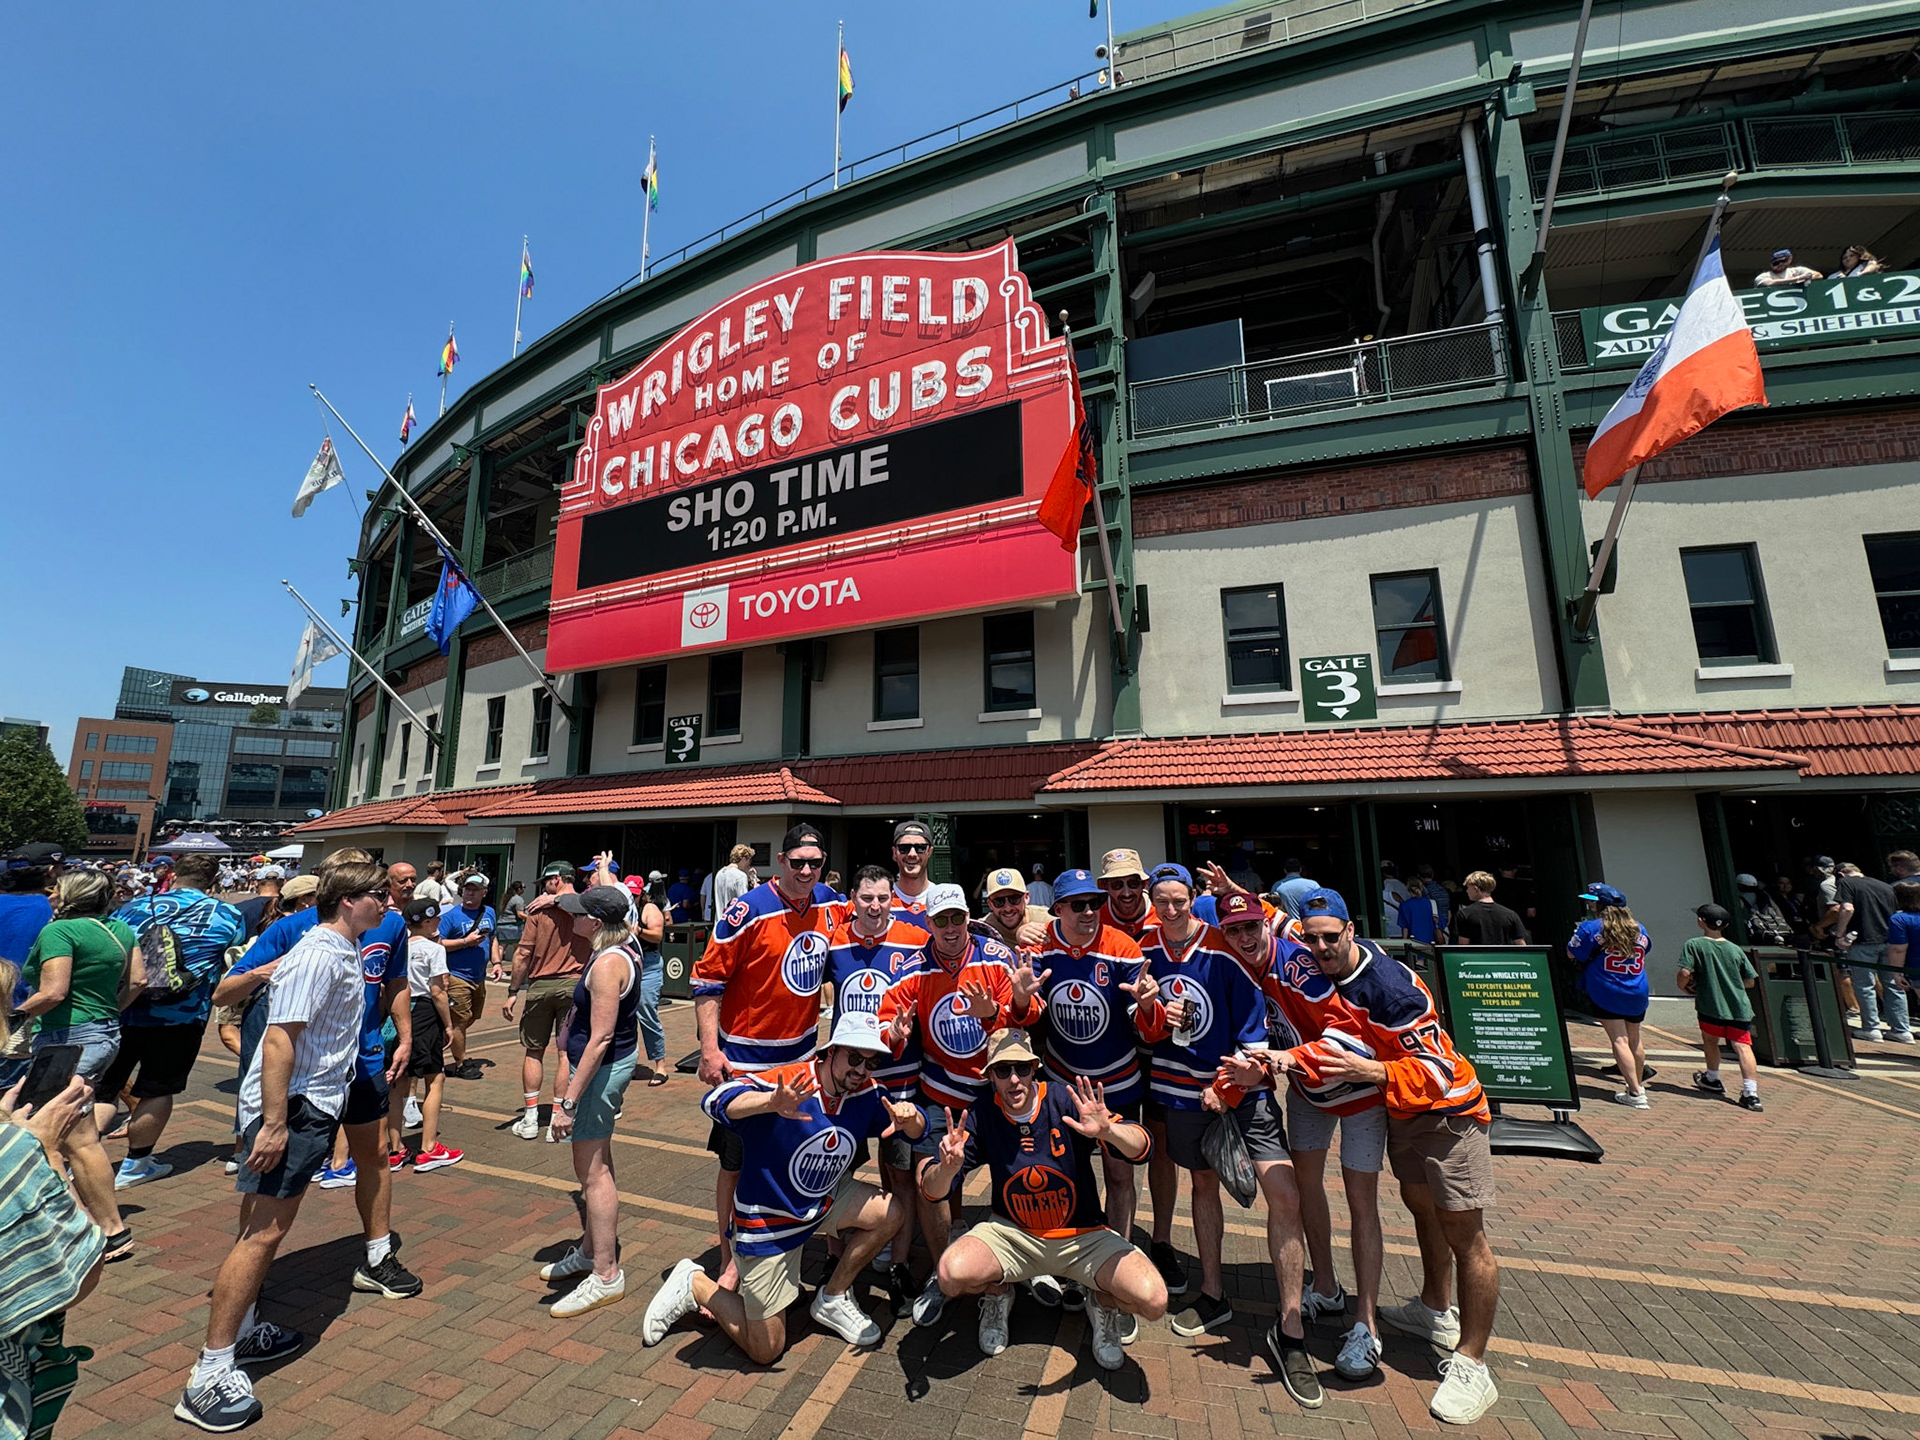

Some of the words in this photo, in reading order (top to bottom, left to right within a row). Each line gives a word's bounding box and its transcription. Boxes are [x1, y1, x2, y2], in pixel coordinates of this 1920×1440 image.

[1602, 287, 1808, 334] GAES
[606, 287, 804, 438] WRIGLEY
[829, 276, 989, 323] FIELD
[694, 357, 789, 411] HOME
[817, 332, 865, 369] OF
[601, 402, 801, 495] CHICAGO
[830, 346, 993, 430] CUBS
[667, 482, 754, 532] SHO
[769, 445, 889, 506] TIME
[707, 517, 766, 552] 1:20
[777, 505, 837, 537] P.M.
[739, 577, 861, 620] TOYOTA
[1304, 657, 1367, 672] GATE
[214, 691, 283, 705] Gallagher
[1316, 670, 1361, 707] 3
[670, 715, 700, 728] GATE
[672, 726, 695, 754] 3
[824, 907, 835, 932] A
[790, 951, 827, 982] OILERS
[1095, 962, 1109, 986] C
[1285, 954, 1322, 989] 29
[1458, 971, 1484, 979] Welcome
[1604, 946, 1645, 975] 23
[1055, 1003, 1100, 1033] OILERS
[1398, 1021, 1446, 1055] 97
[1496, 1074, 1516, 1082] Thank
[1520, 1075, 1532, 1085] You
[1050, 1128, 1066, 1157] C
[802, 1153, 849, 1186] OILERS
[1011, 1187, 1070, 1225] OILERS
